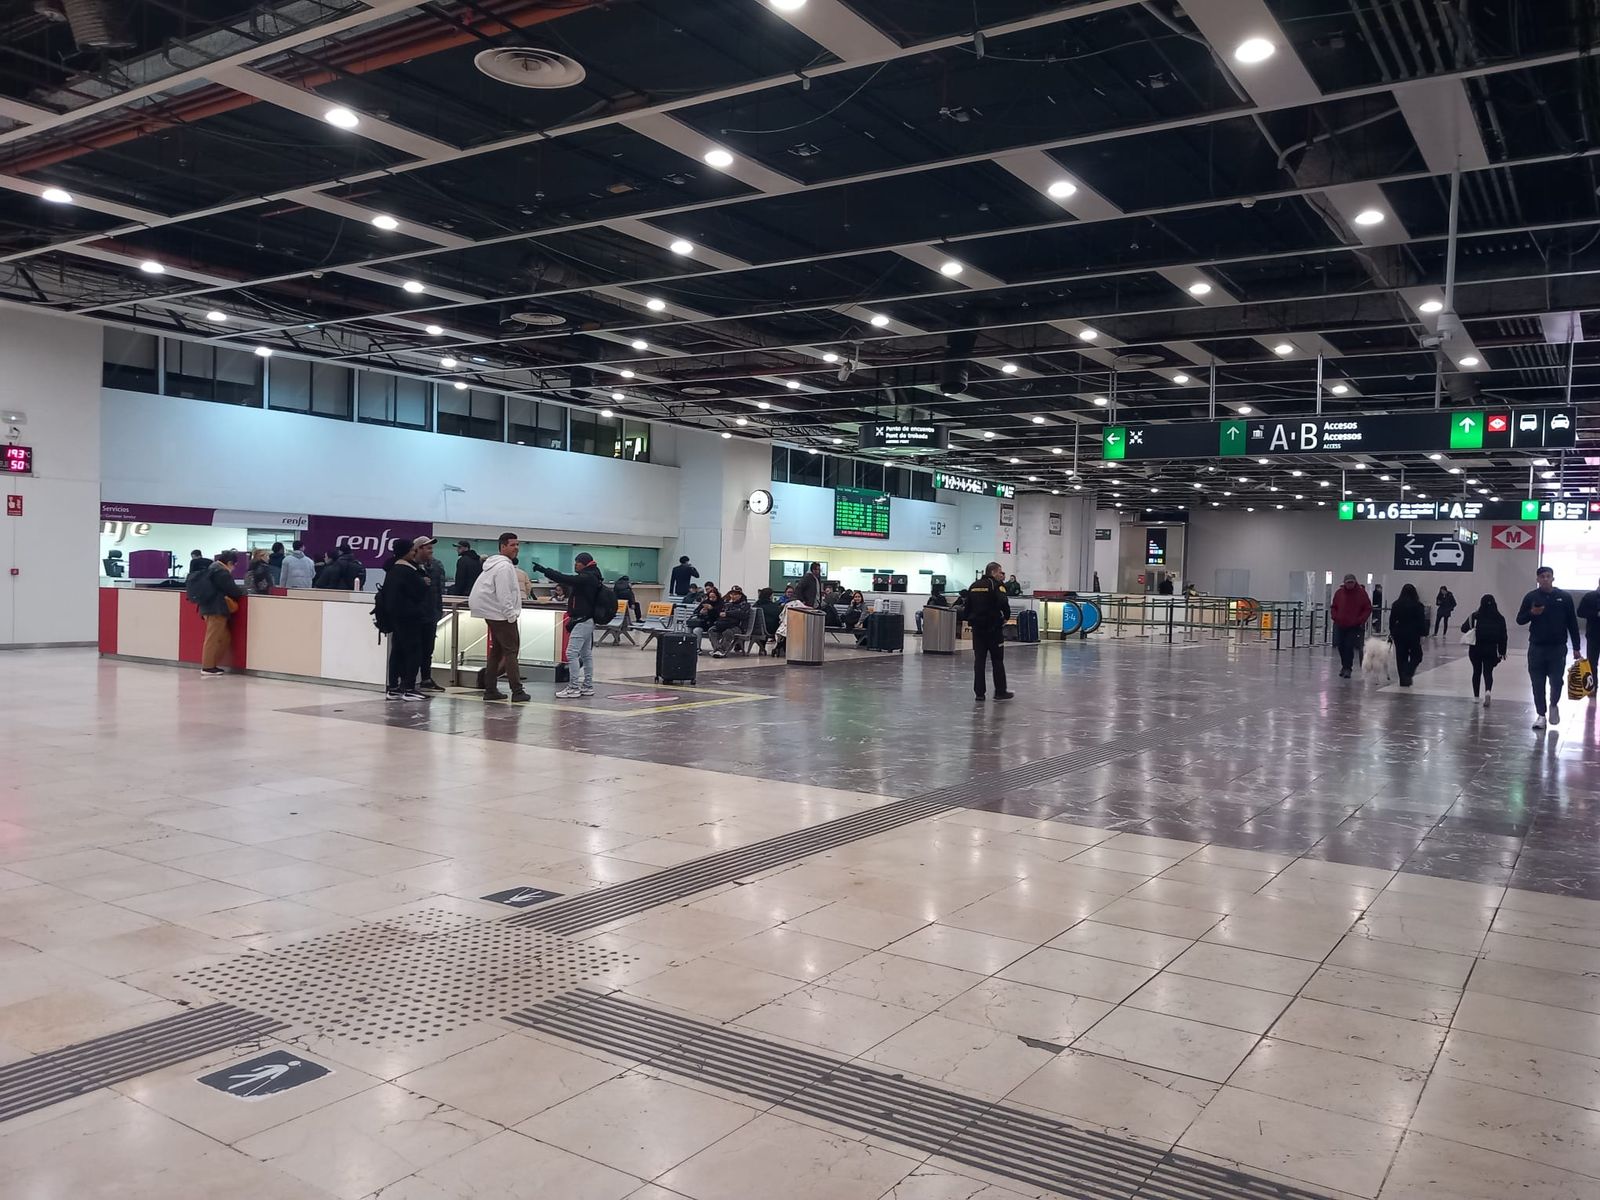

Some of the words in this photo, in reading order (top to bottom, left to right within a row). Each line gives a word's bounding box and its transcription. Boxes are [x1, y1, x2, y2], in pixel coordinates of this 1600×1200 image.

[1323, 421, 1358, 430] Accesos
[1323, 433, 1362, 441] Accessos
[1450, 503, 1464, 518] A
[1553, 502, 1567, 519] B
[282, 516, 307, 526] renfe
[1505, 531, 1522, 543] M
[1405, 558, 1423, 566] Taxi
